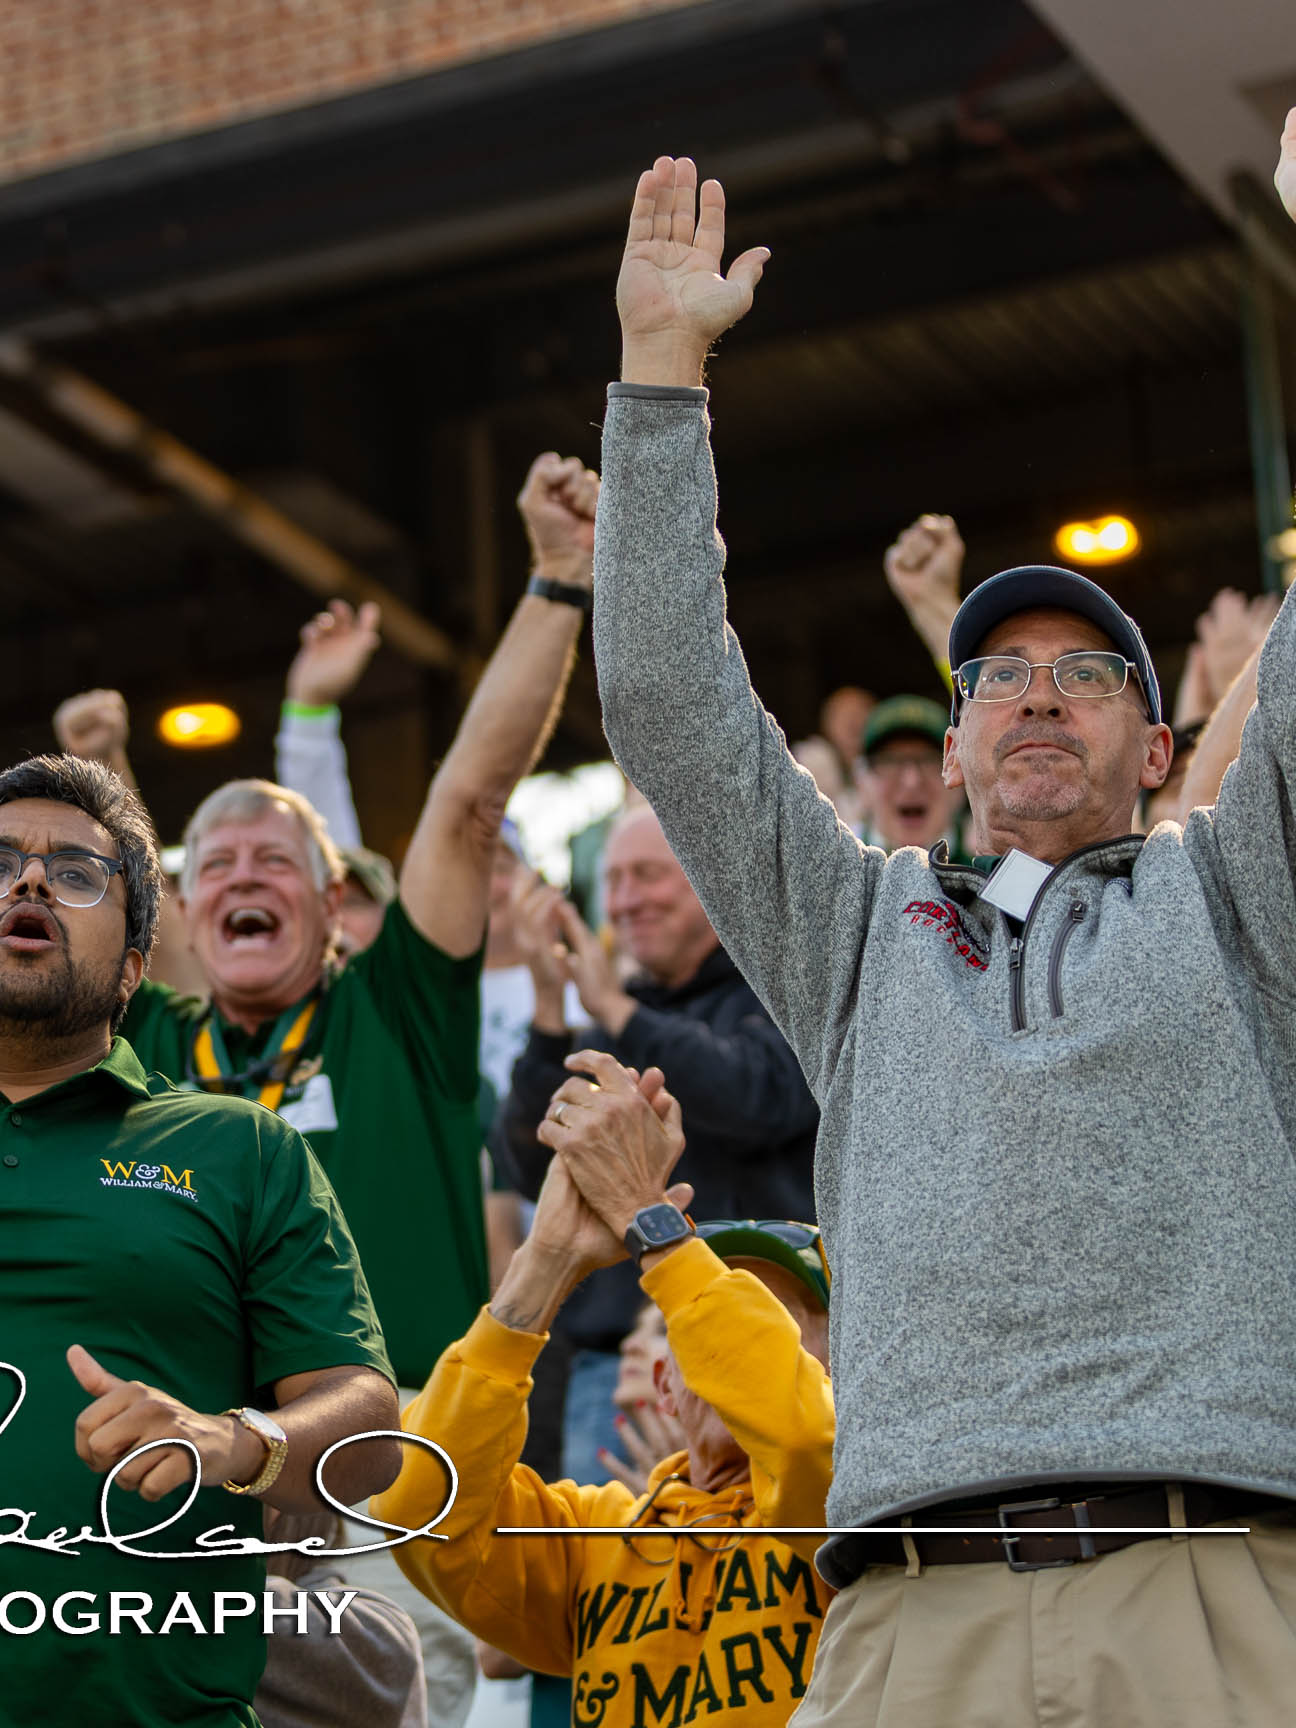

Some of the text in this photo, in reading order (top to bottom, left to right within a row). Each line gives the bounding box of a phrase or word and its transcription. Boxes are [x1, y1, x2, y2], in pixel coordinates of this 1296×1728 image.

[100, 1158, 197, 1193] W&M
[573, 1622, 813, 1728] & MARY
